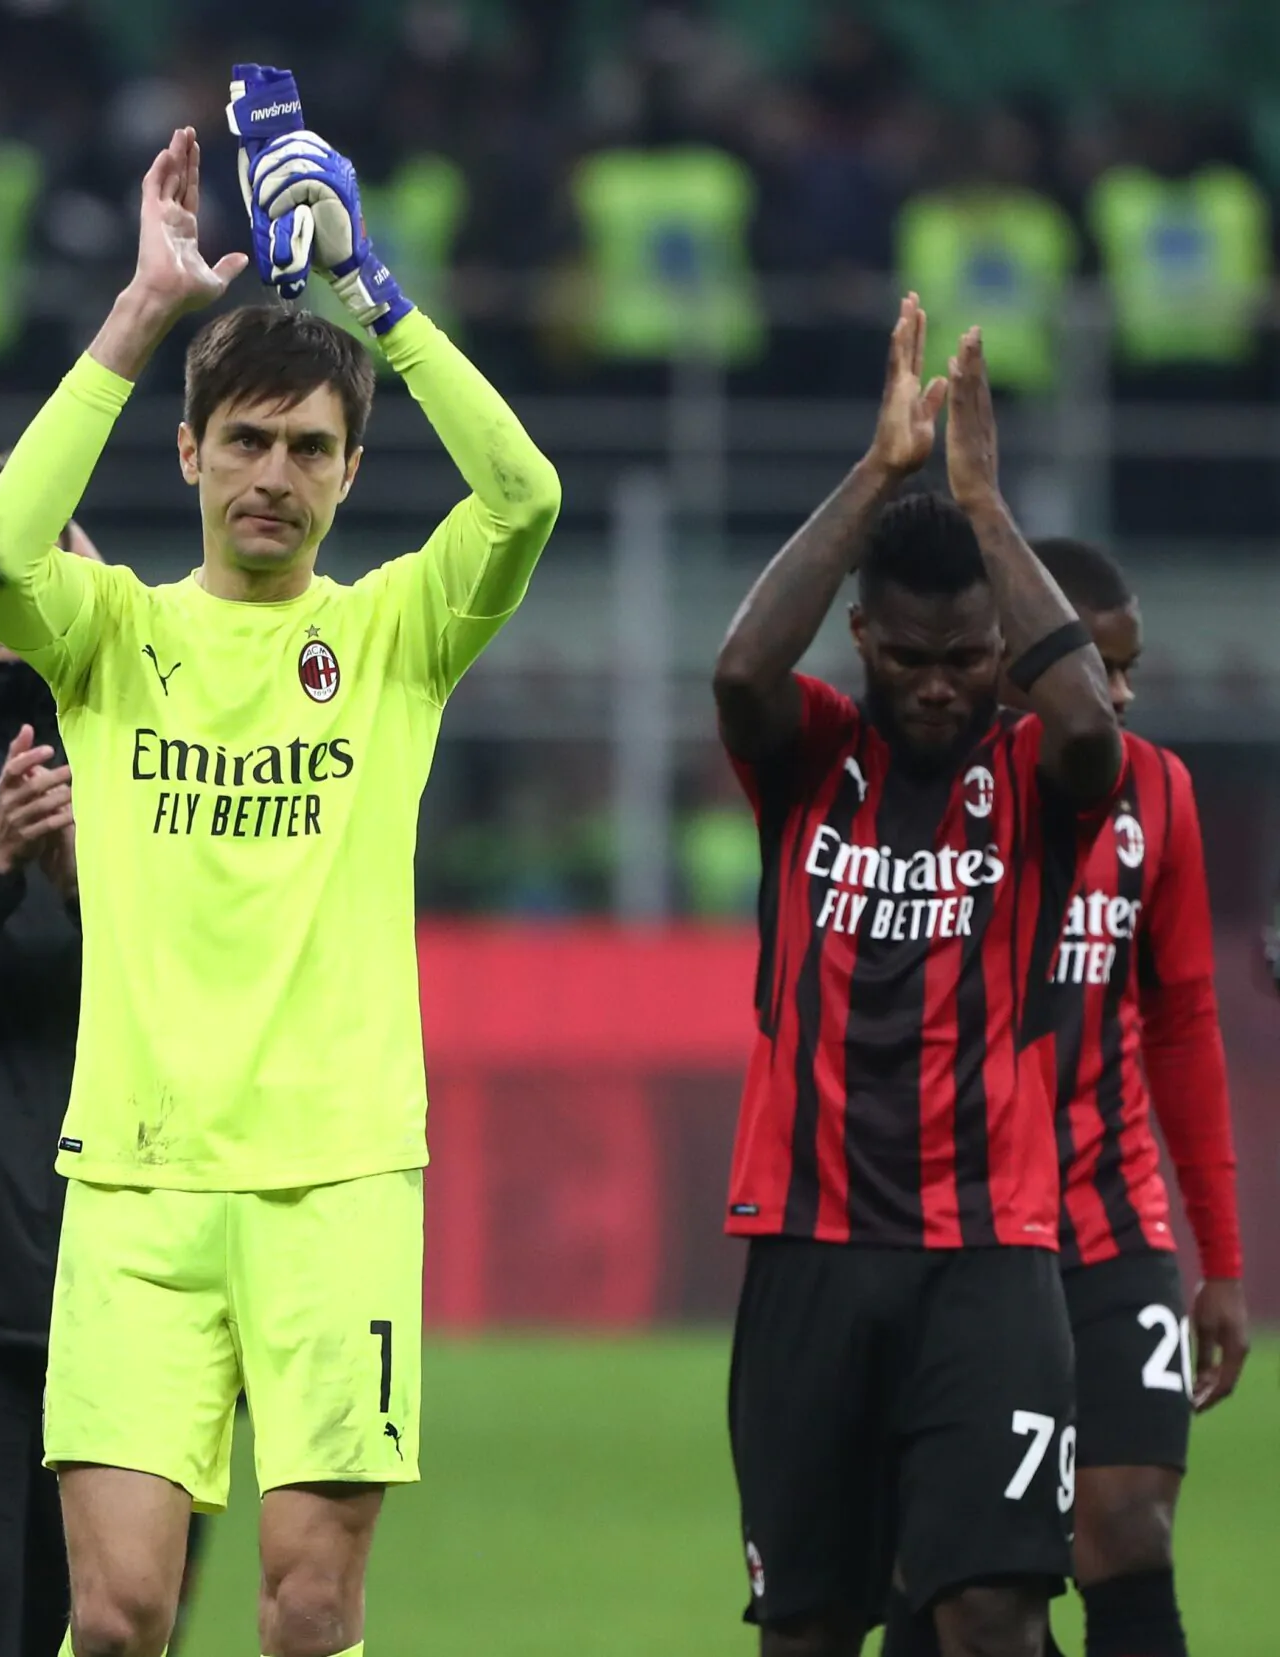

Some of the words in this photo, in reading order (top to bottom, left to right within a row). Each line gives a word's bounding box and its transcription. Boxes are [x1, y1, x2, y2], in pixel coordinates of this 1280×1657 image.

[132, 728, 354, 787] Emirates
[153, 792, 201, 834] FLY
[210, 794, 322, 837] BETTER
[805, 823, 1005, 894] Emirates
[816, 888, 868, 935] FLY
[870, 895, 974, 941] BETTER
[370, 1320, 392, 1413] 1
[1004, 1410, 1077, 1513] 79
